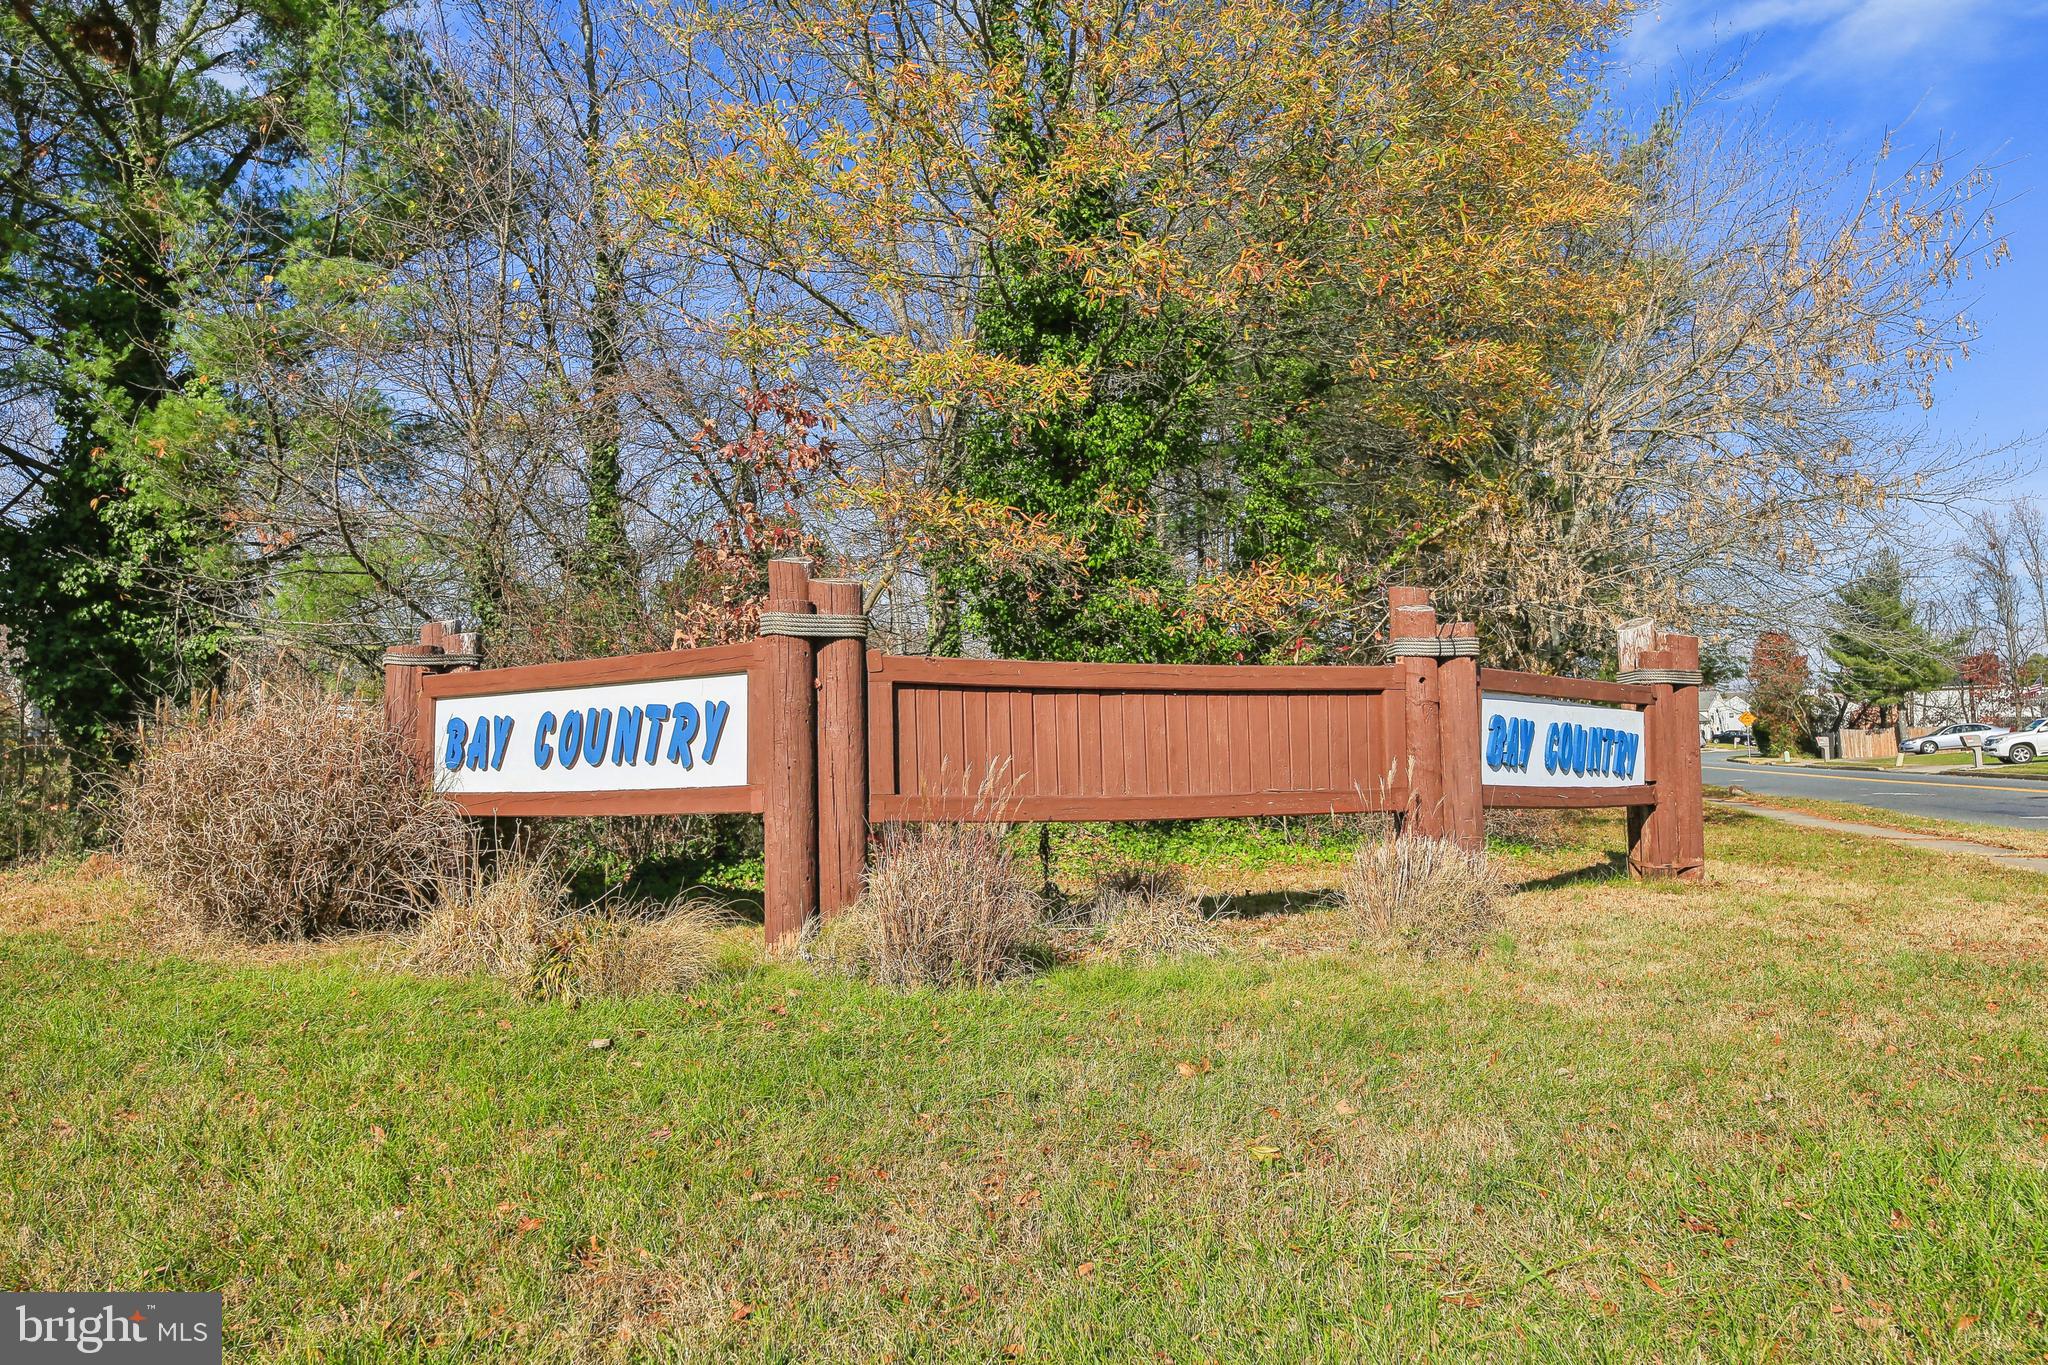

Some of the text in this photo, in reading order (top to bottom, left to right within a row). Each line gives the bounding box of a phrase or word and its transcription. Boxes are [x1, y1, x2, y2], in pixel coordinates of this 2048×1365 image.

[445, 700, 731, 771] BAY COUNTRY
[1486, 714, 1639, 780] BAY COUNTRY
